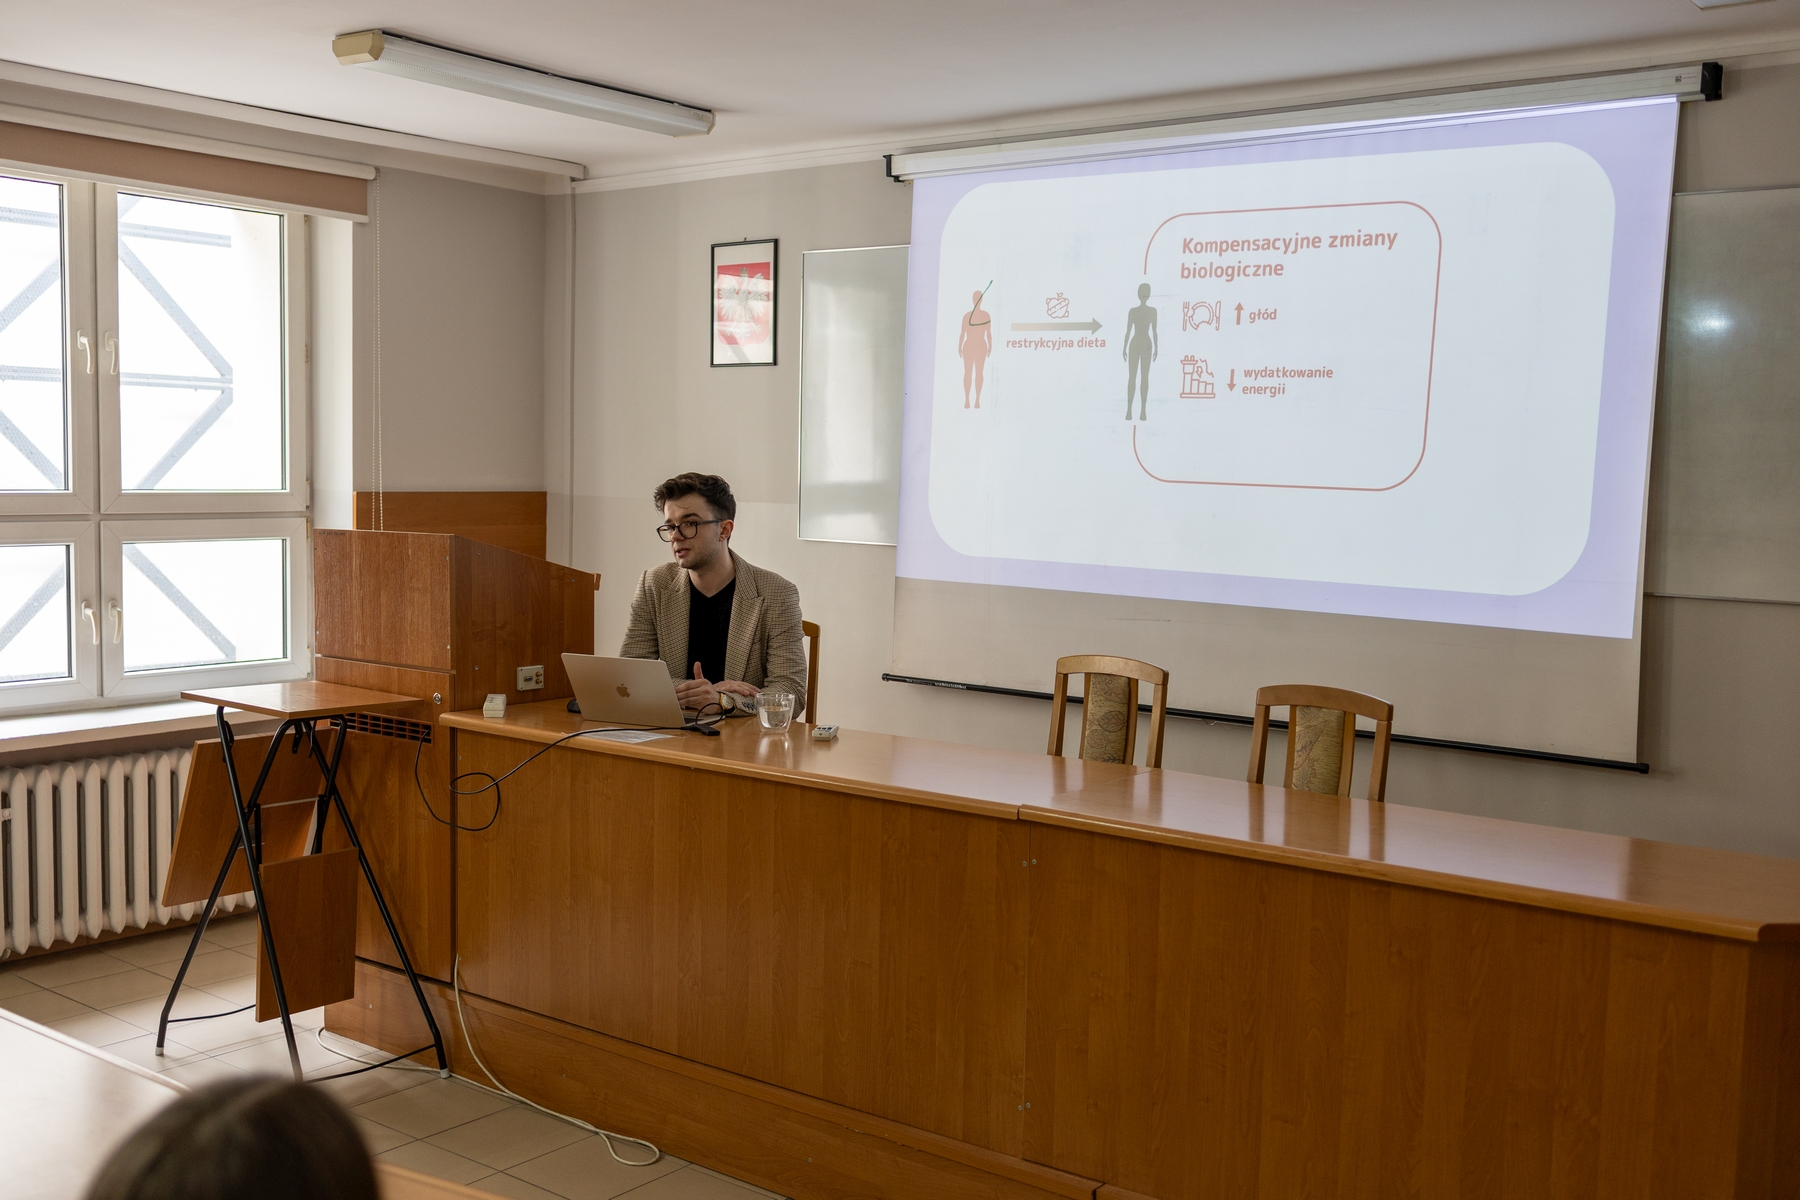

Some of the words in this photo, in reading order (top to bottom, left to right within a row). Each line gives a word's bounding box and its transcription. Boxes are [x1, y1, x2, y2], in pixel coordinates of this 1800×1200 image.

[1181, 233, 1323, 256] Kompensacyjne
[1327, 230, 1398, 251] zmiany
[1180, 262, 1285, 282] biologiczne
[1248, 308, 1278, 324] głód
[1006, 337, 1075, 350] restrykcyjna
[1076, 336, 1107, 348] dieta
[1243, 366, 1334, 380] wydatkowanie
[1241, 384, 1287, 399] energii
